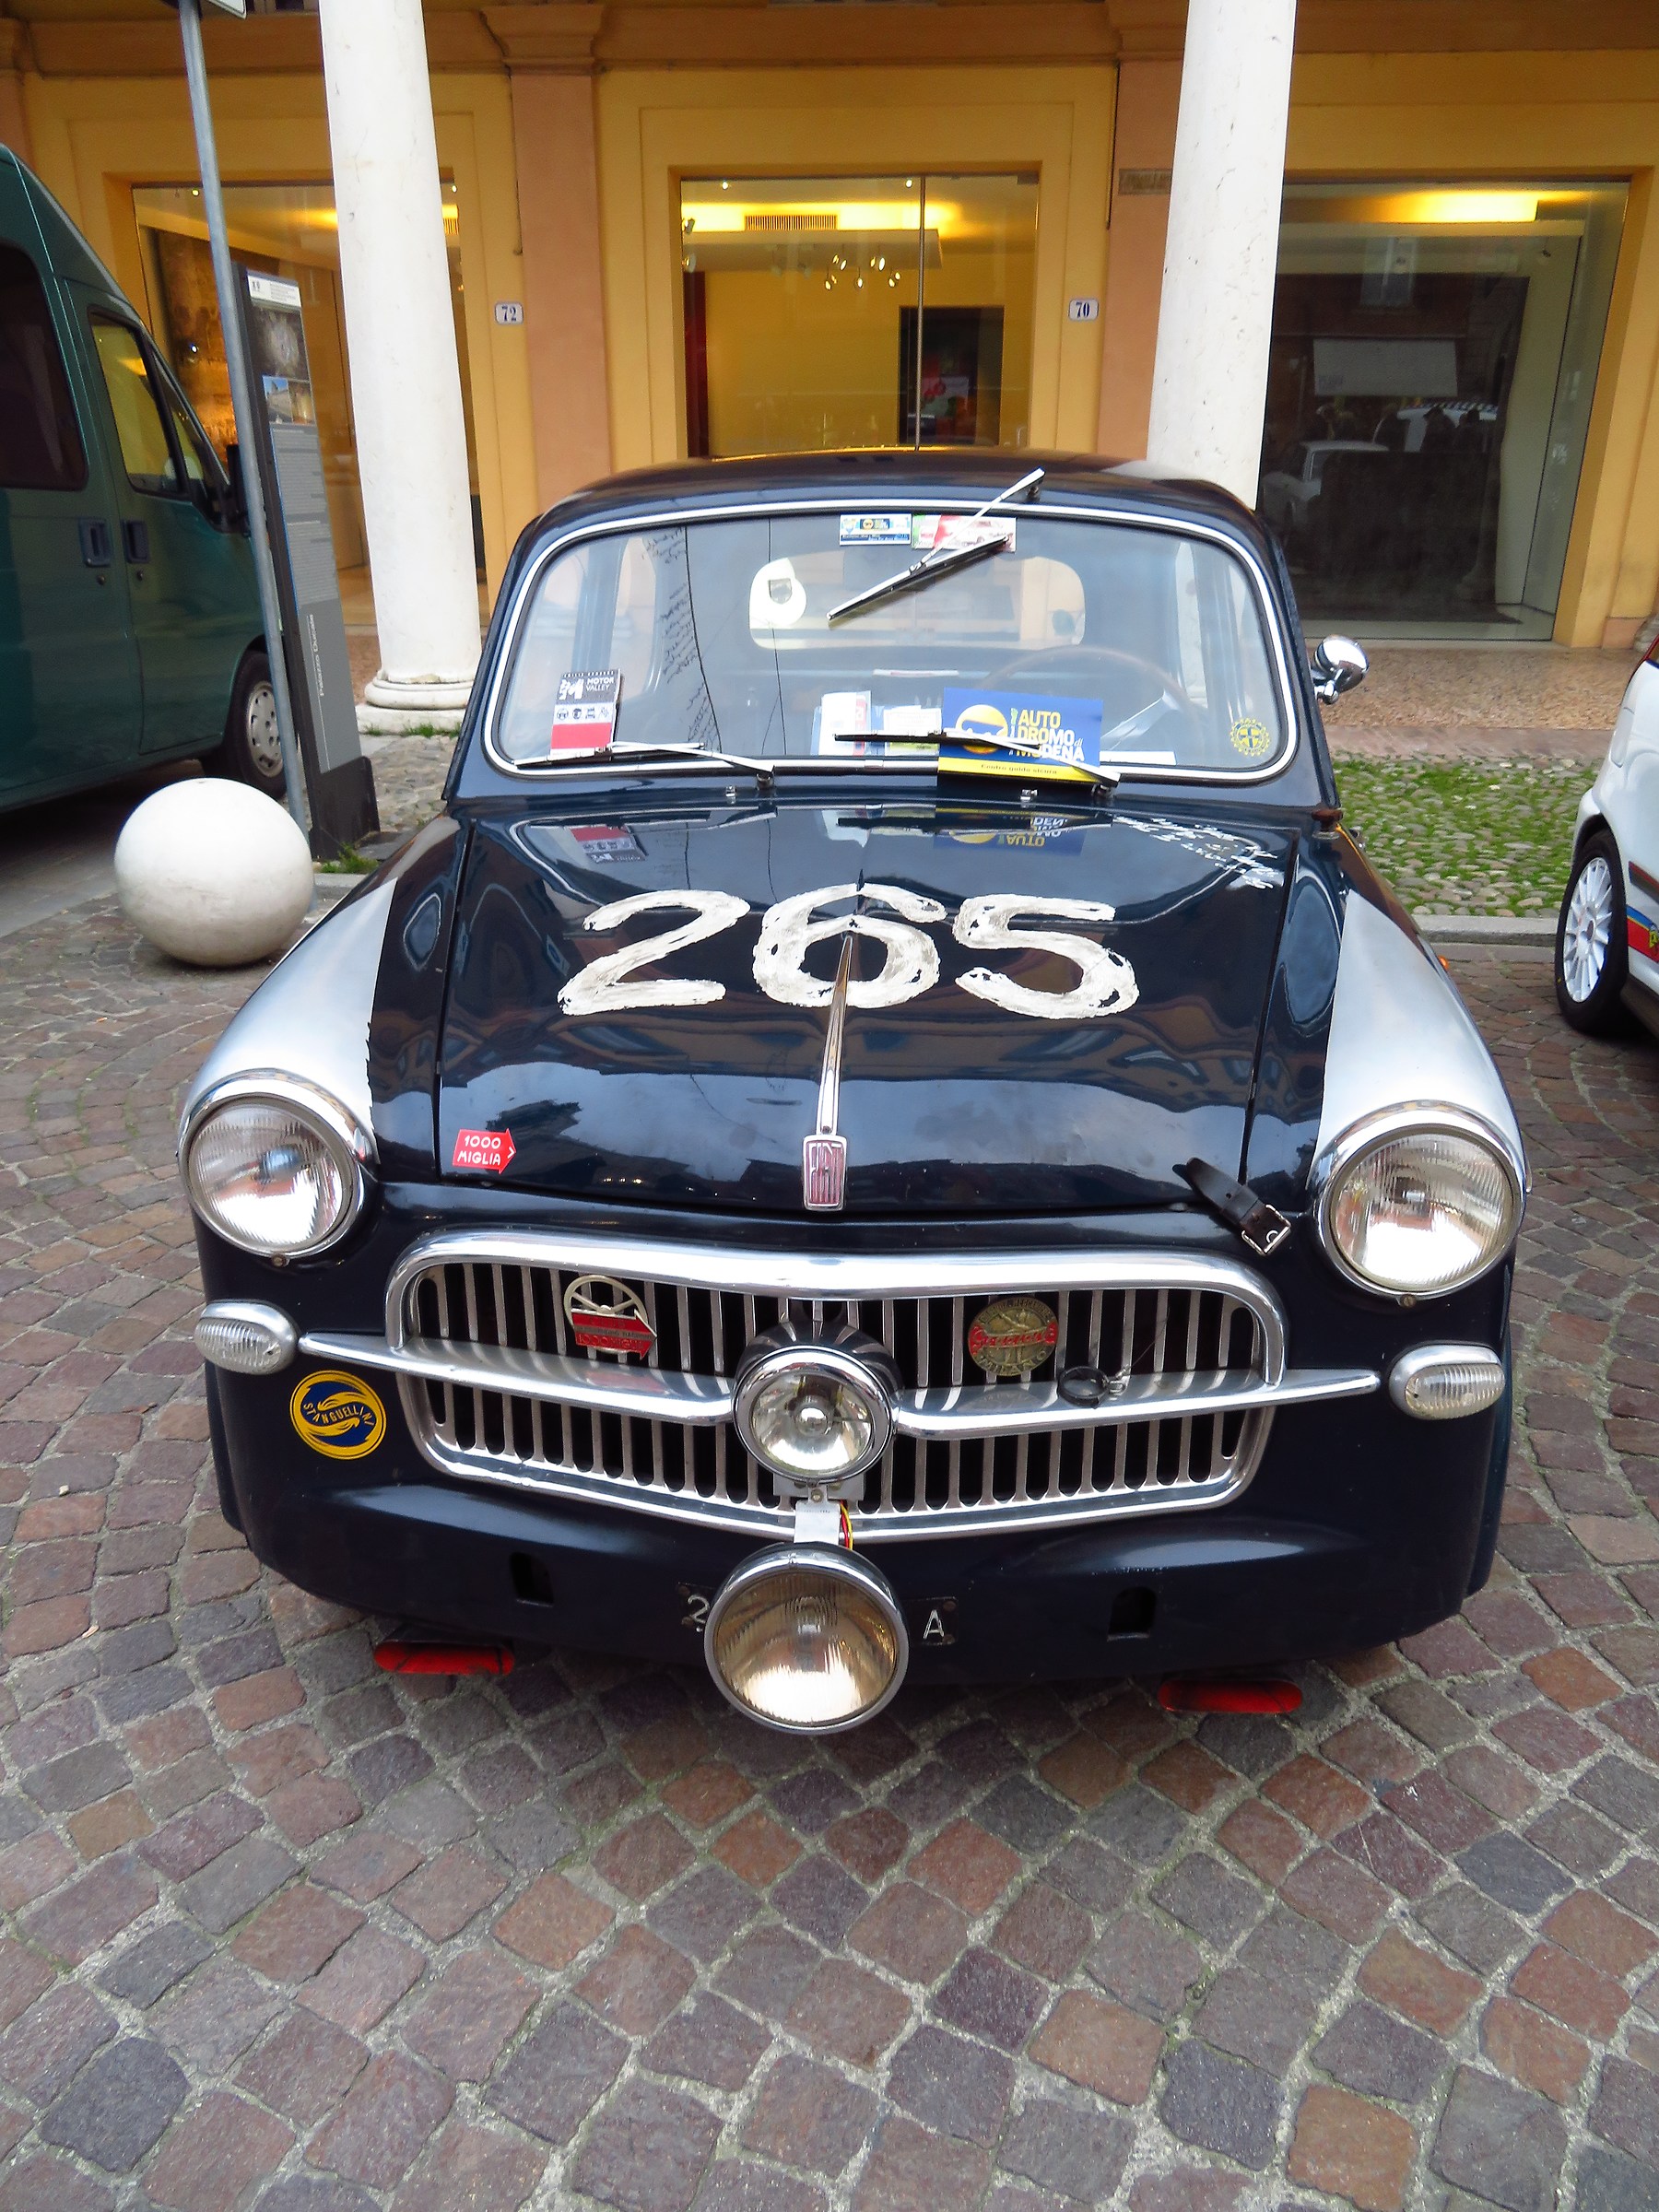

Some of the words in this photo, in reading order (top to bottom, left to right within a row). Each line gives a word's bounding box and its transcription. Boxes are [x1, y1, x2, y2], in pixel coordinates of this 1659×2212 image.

[501, 305, 517, 322] 72
[1076, 301, 1090, 318] 70
[1018, 709, 1061, 728] AUTO
[1017, 725, 1076, 747] DROMO
[557, 882, 1141, 1020] 265
[464, 1135, 501, 1149] 1000
[456, 1149, 501, 1166] MIGLIA
[303, 1402, 375, 1427] STANGUELLINI
[923, 1608, 945, 1640] A
